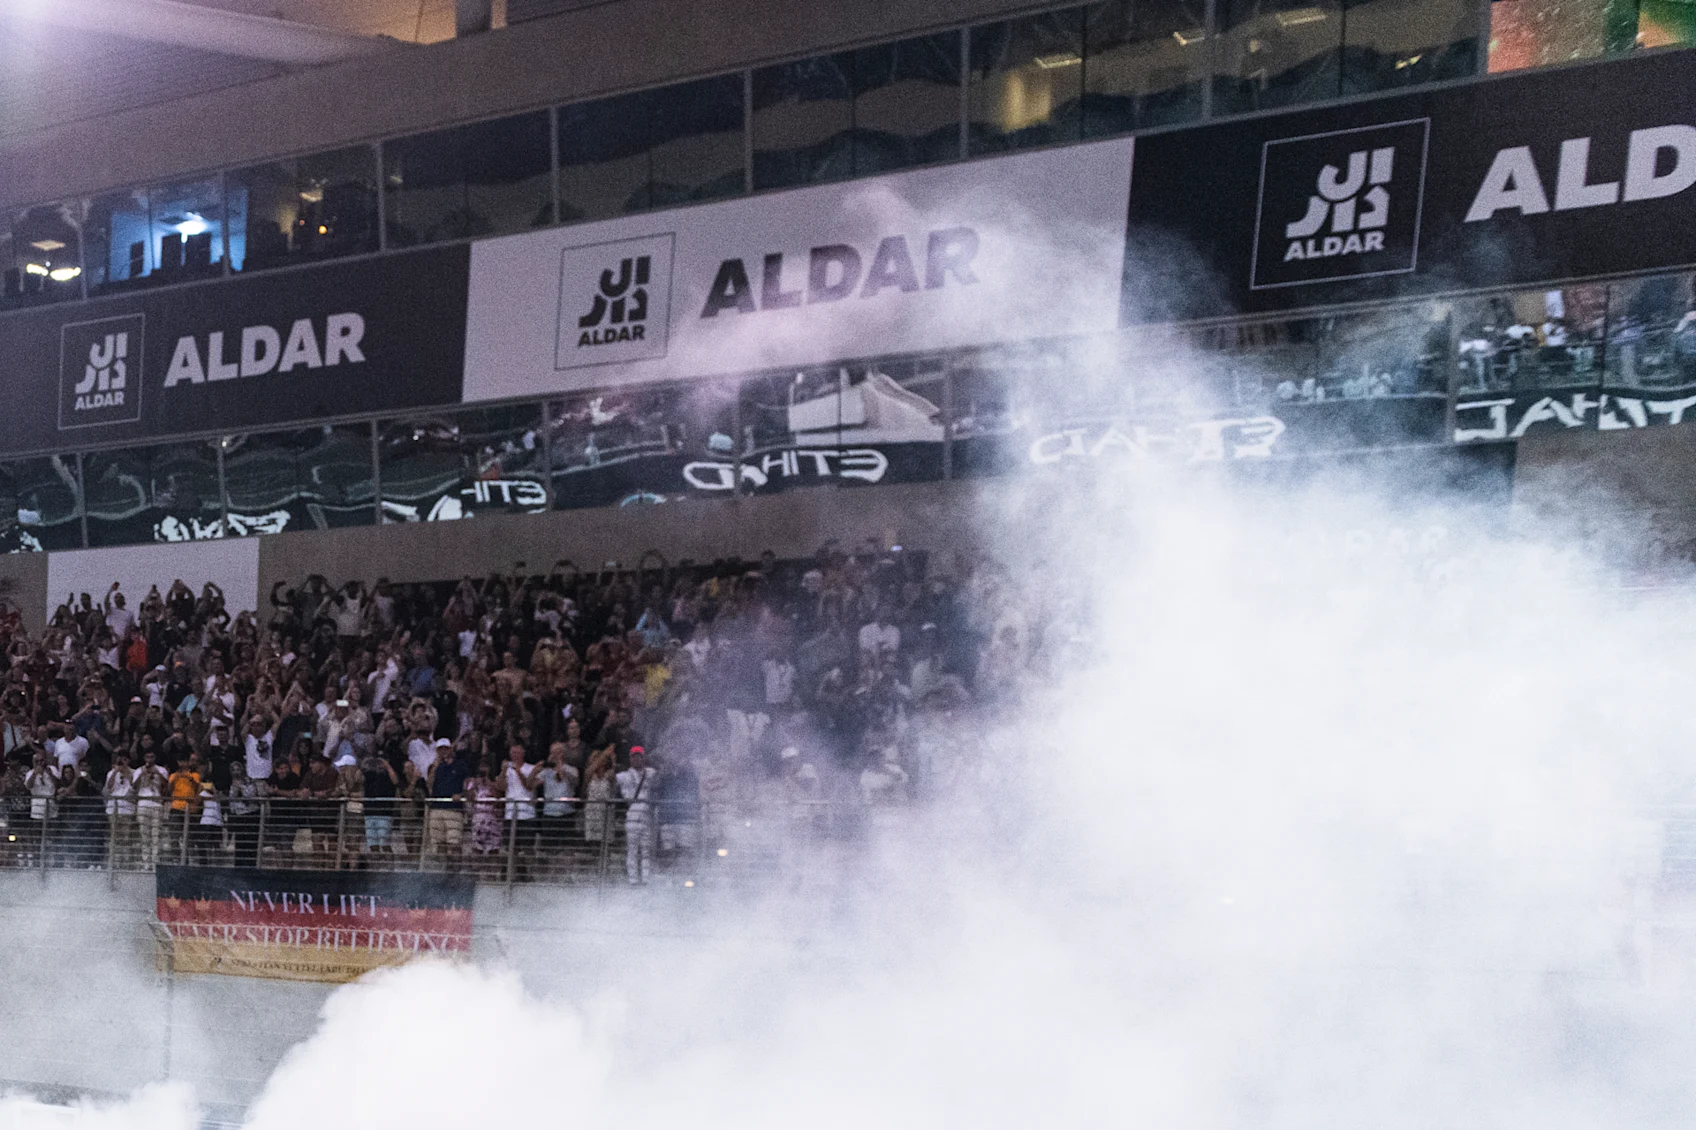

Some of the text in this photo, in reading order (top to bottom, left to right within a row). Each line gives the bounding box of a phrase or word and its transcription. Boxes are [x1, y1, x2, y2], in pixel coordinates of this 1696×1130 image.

[1464, 124, 1696, 223] ALD
[1284, 229, 1384, 262] ALDAR
[699, 226, 981, 319] ALDAR
[163, 312, 366, 388] ALDAR
[578, 324, 645, 347] ALDAR
[74, 391, 124, 411] ALDAR
[230, 890, 314, 914] NEVER
[246, 924, 310, 950] STOP
